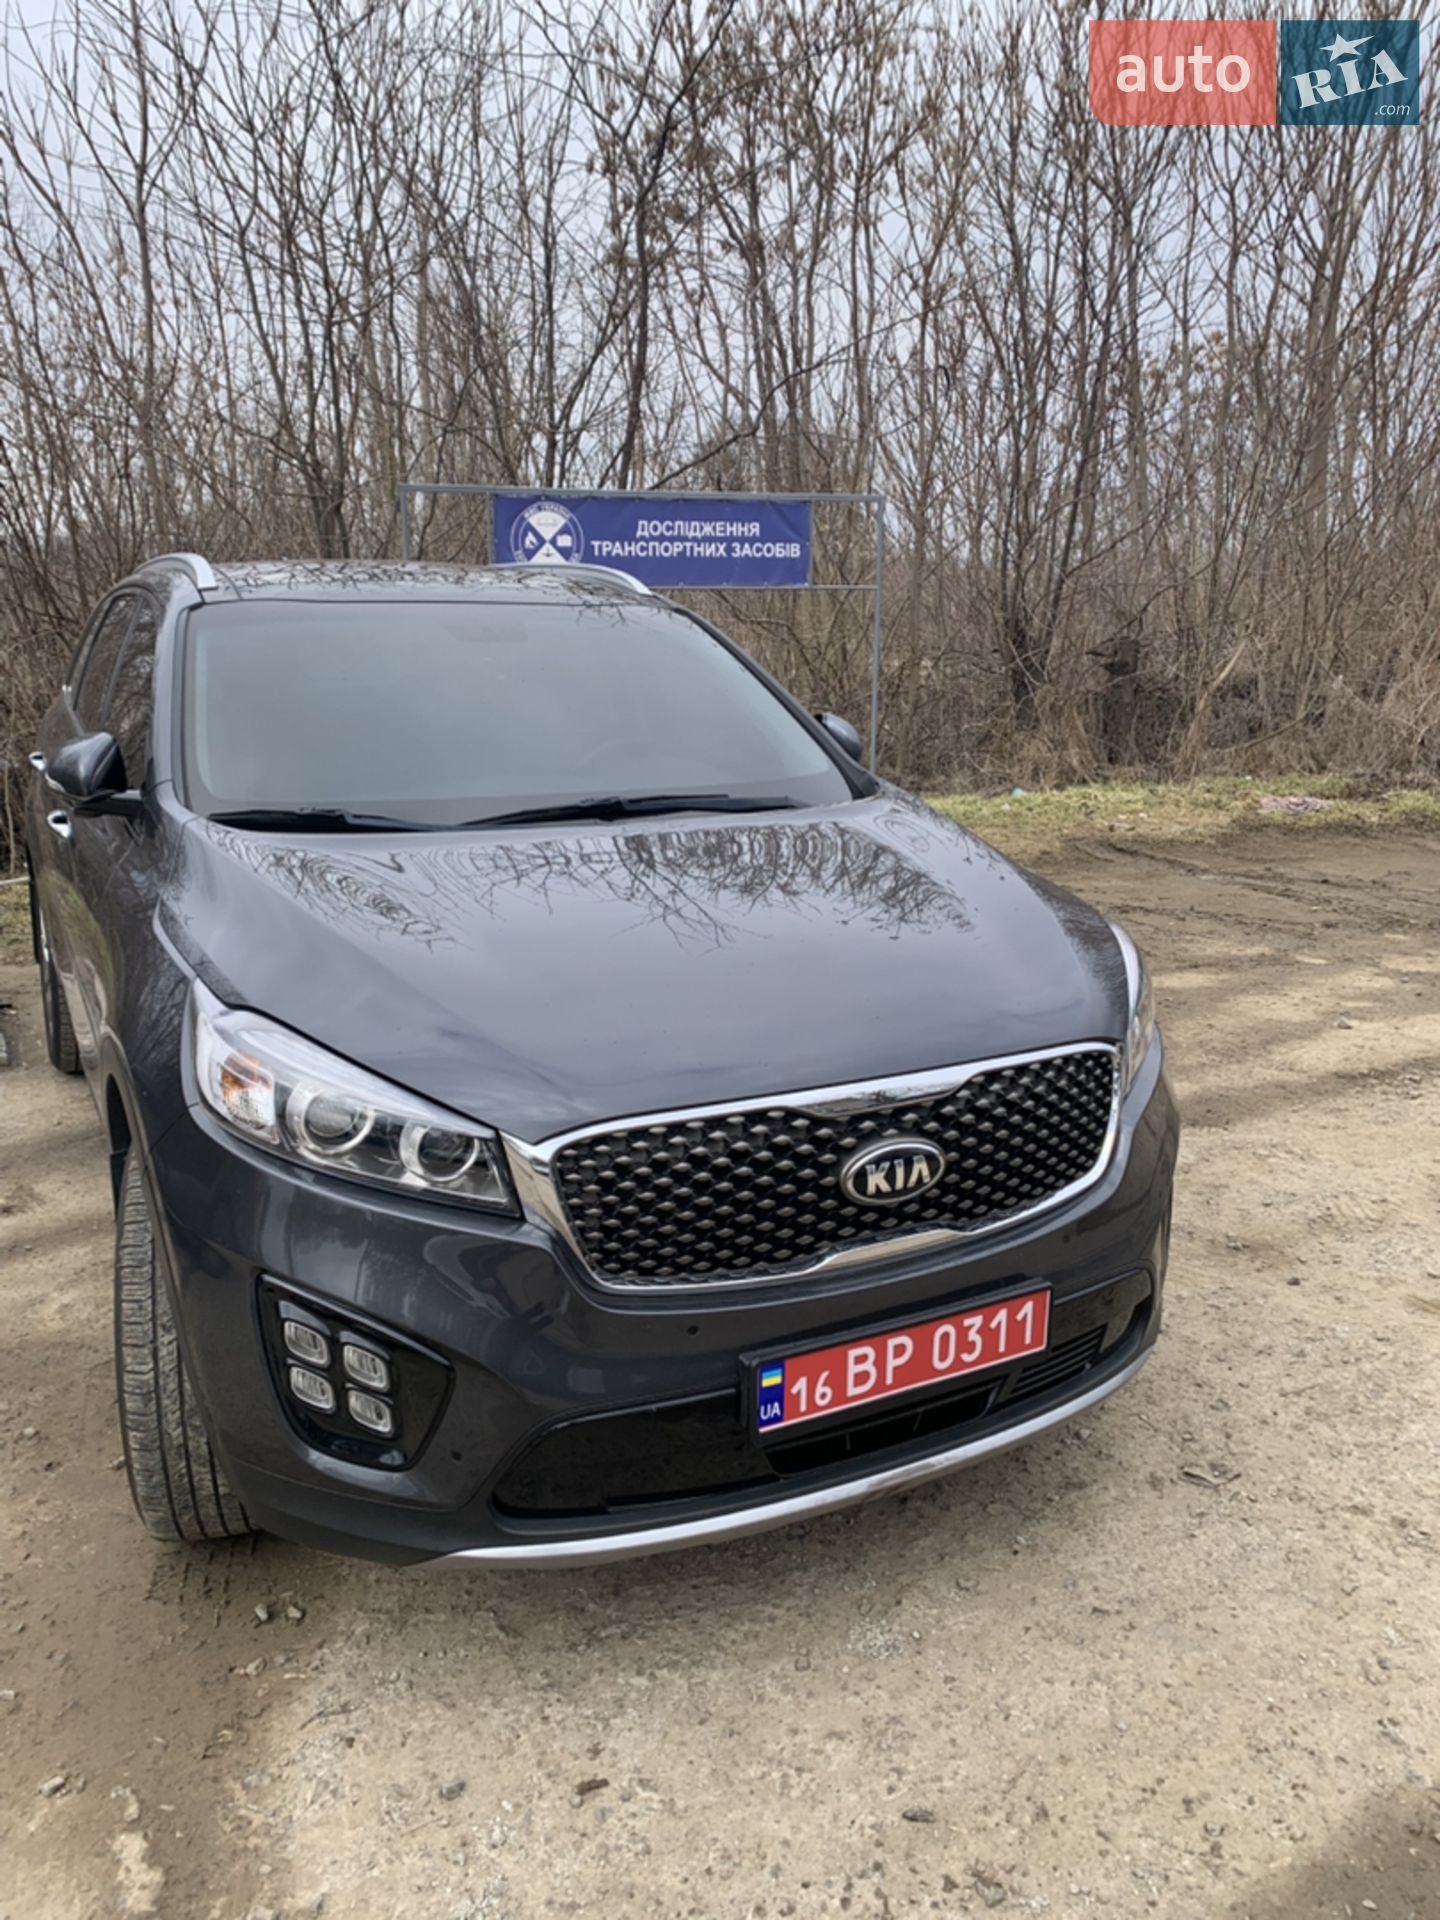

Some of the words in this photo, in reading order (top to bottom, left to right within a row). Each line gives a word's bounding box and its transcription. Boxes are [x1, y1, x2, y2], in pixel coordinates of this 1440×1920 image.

[636, 520, 760, 538] ДОСЛІДЖЕННЯ
[591, 540, 727, 557] ТРАНСПОРТНИХ
[731, 542, 801, 557] ЗАСОБІВ
[865, 1155, 931, 1196] KIA
[790, 1371, 832, 1412] 16
[931, 1301, 1034, 1370] 0311
[760, 1402, 781, 1420] UA
